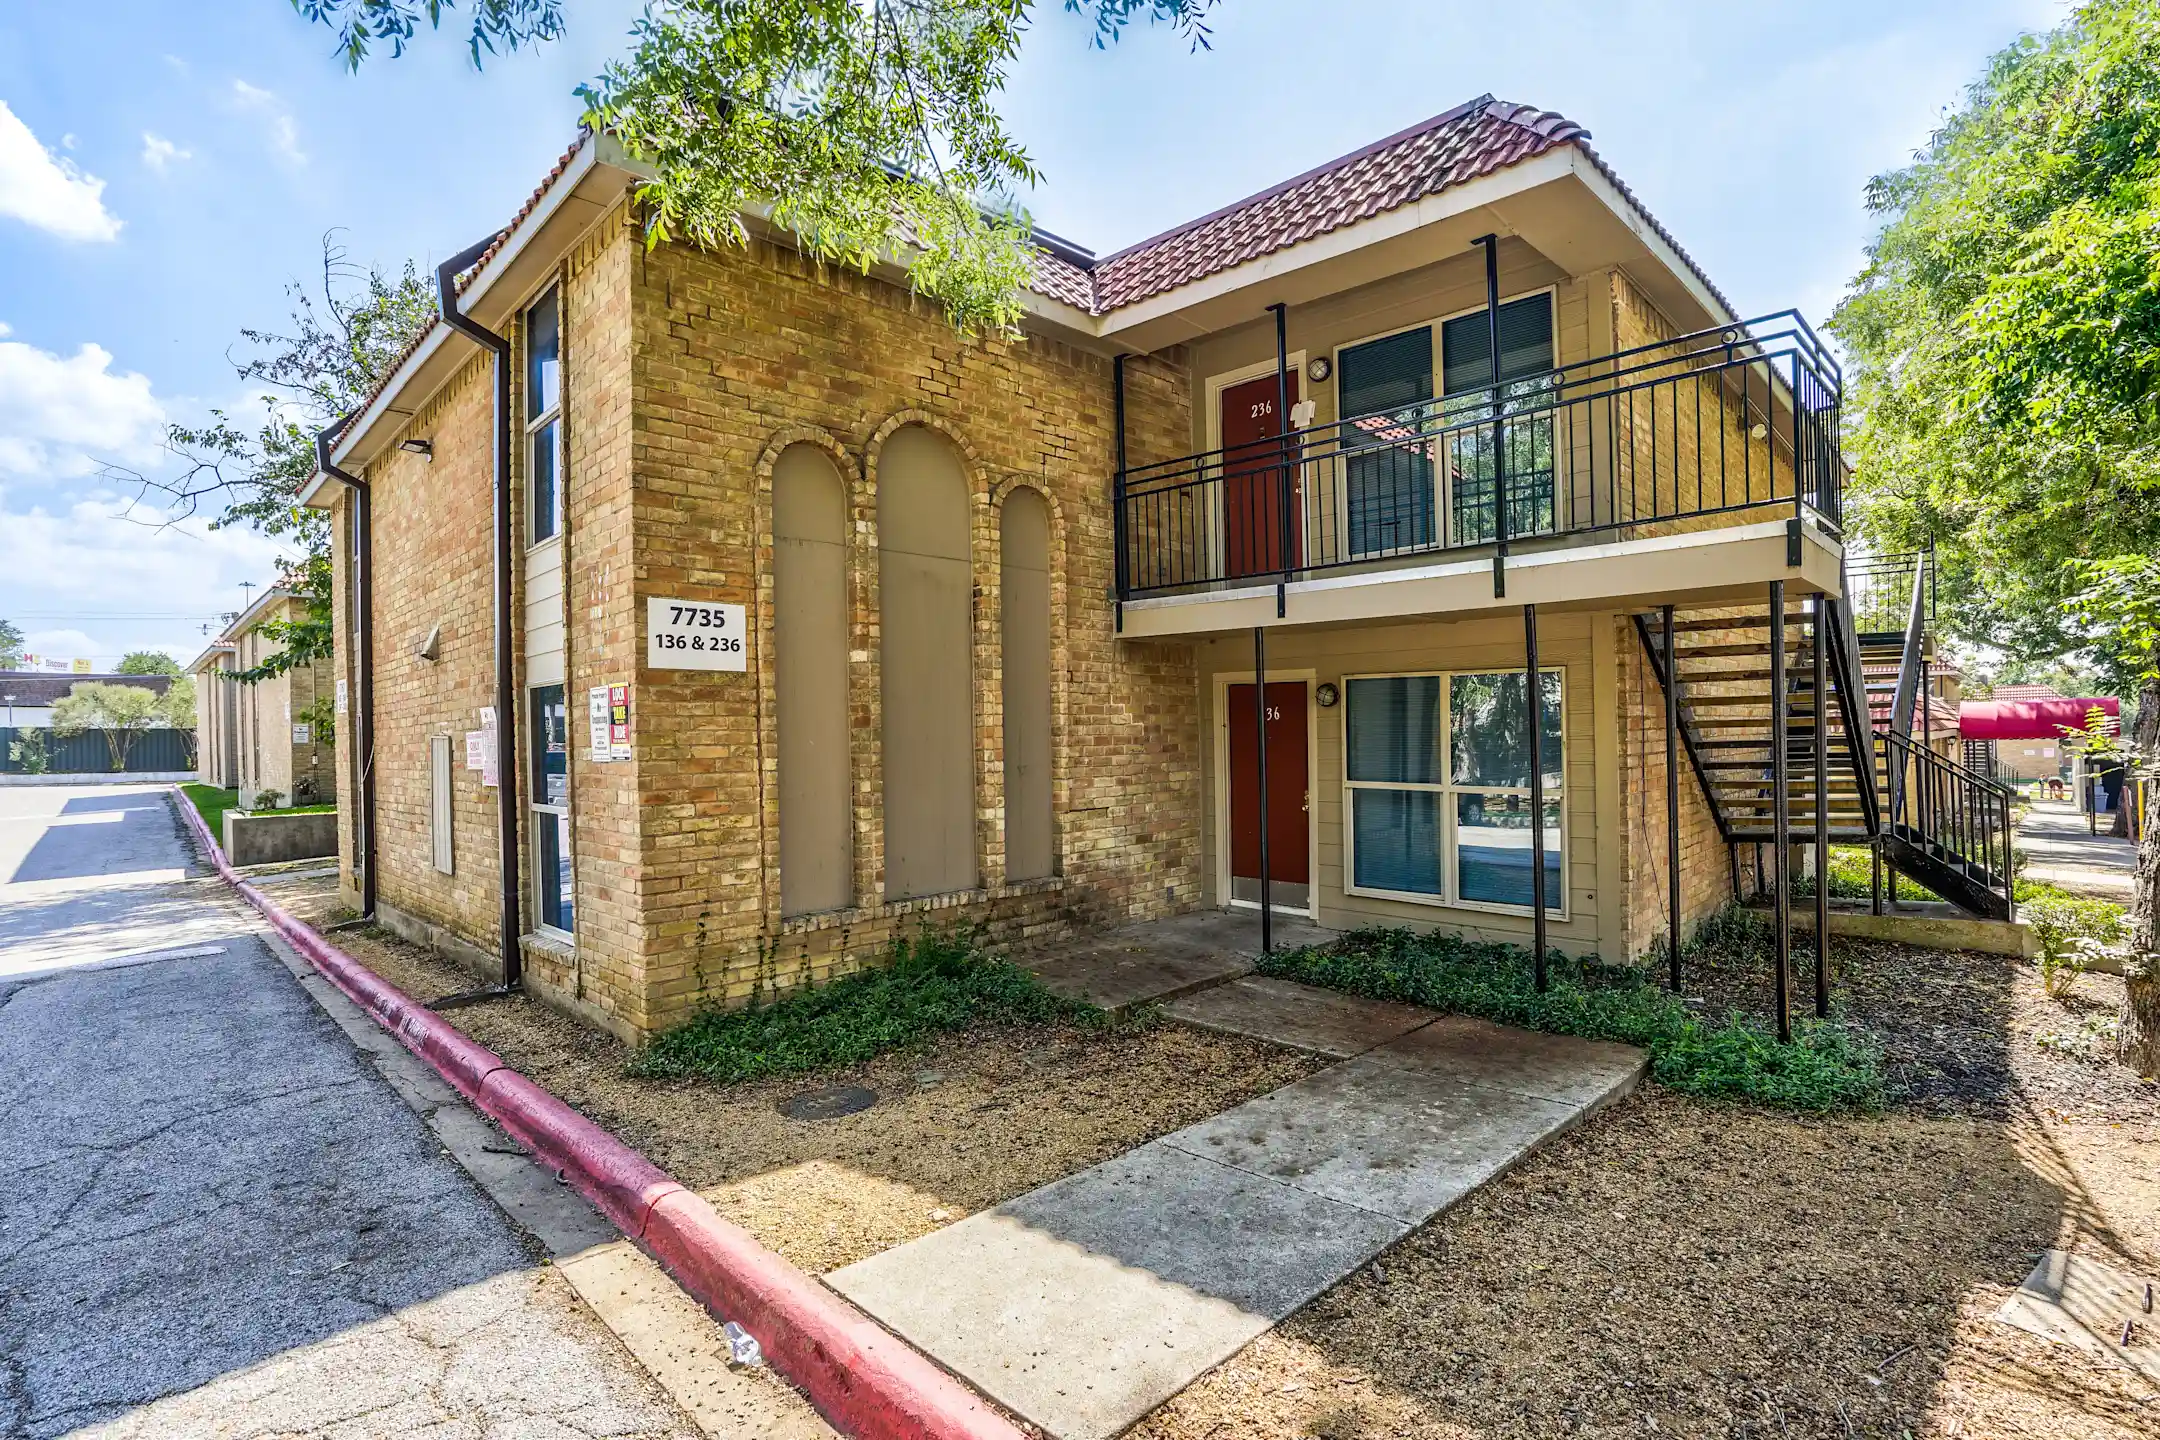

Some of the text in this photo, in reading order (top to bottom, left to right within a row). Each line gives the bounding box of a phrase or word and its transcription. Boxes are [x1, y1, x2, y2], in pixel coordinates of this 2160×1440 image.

[1251, 400, 1272, 418] 236
[670, 606, 725, 628] 7735
[655, 634, 740, 652] 136 & 236
[45, 659, 68, 669] Discover
[612, 706, 626, 720] TAKE
[1266, 706, 1280, 721] 36
